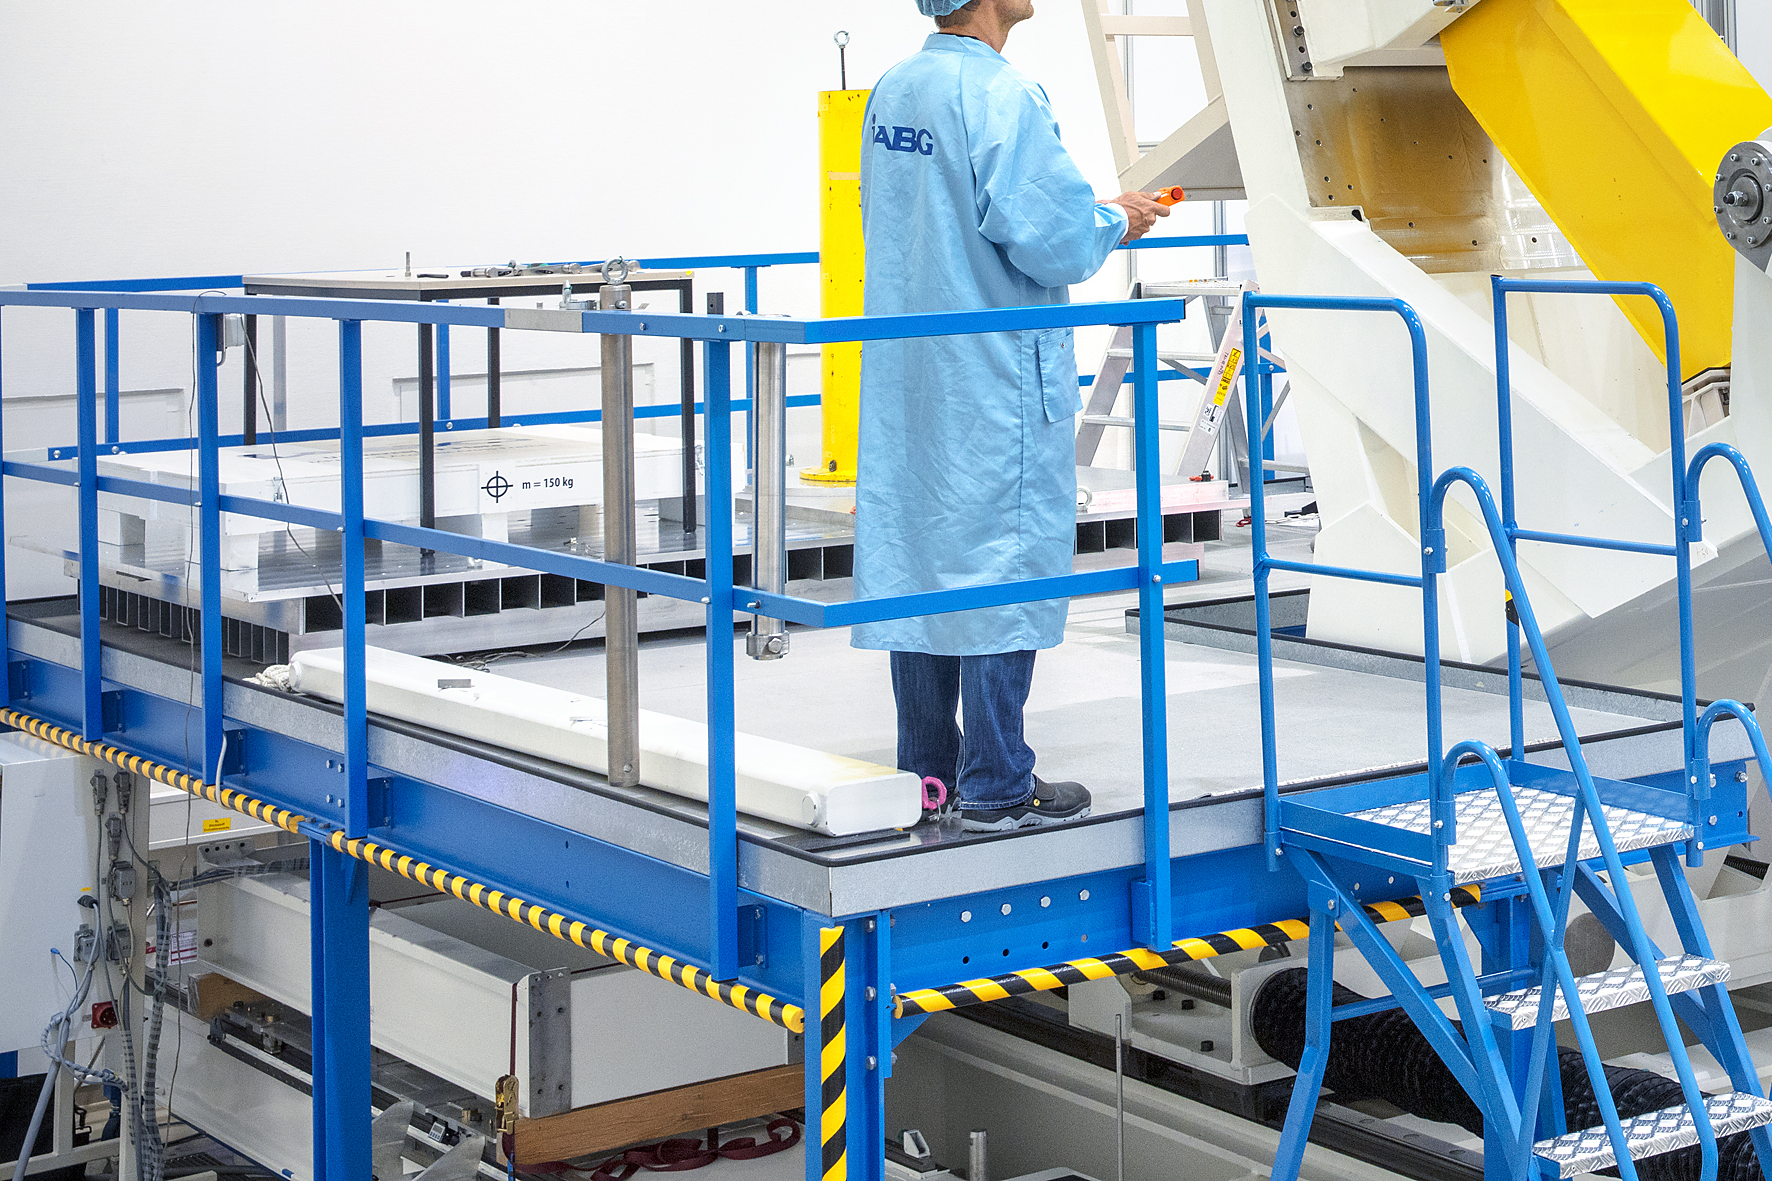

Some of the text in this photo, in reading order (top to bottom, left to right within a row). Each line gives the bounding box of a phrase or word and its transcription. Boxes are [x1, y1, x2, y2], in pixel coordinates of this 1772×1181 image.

[522, 481, 531, 490] m
[543, 477, 561, 488] 150
[562, 476, 574, 489] kg
